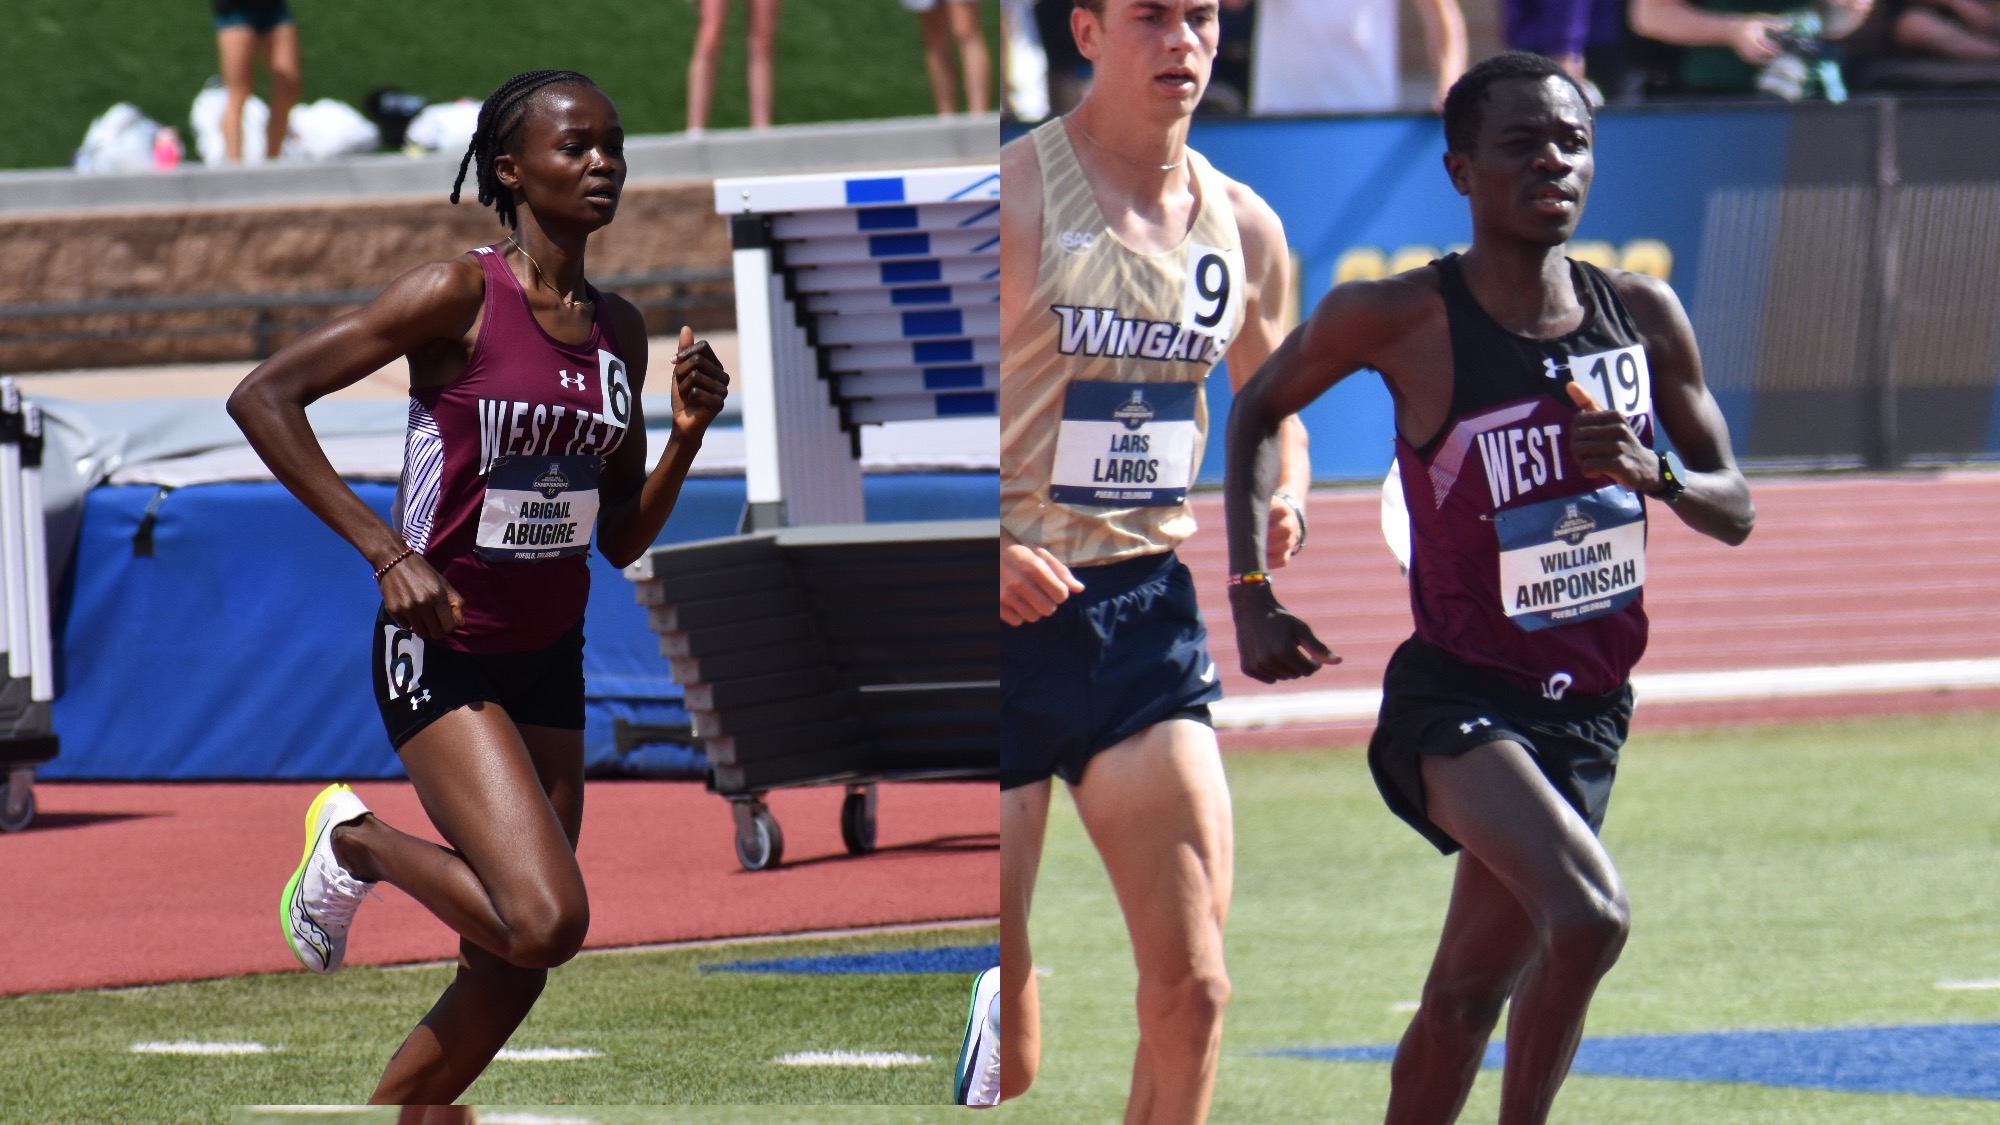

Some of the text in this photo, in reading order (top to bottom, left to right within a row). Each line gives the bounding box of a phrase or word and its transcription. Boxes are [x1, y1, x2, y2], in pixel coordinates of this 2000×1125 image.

[1194, 254, 1230, 328] 9
[608, 360, 629, 425] 6
[1589, 352, 1640, 412] 19
[478, 398, 566, 476] WEST
[1111, 434, 1151, 453] LARS
[1093, 458, 1159, 483] LAROS
[1478, 424, 1563, 509] WEST
[502, 522, 578, 546] ABUGIRE
[519, 501, 571, 519] ABIGAIL
[1516, 559, 1636, 609] AMPONSAH
[1540, 541, 1612, 574] WILLIAM
[390, 630, 414, 697] 6
